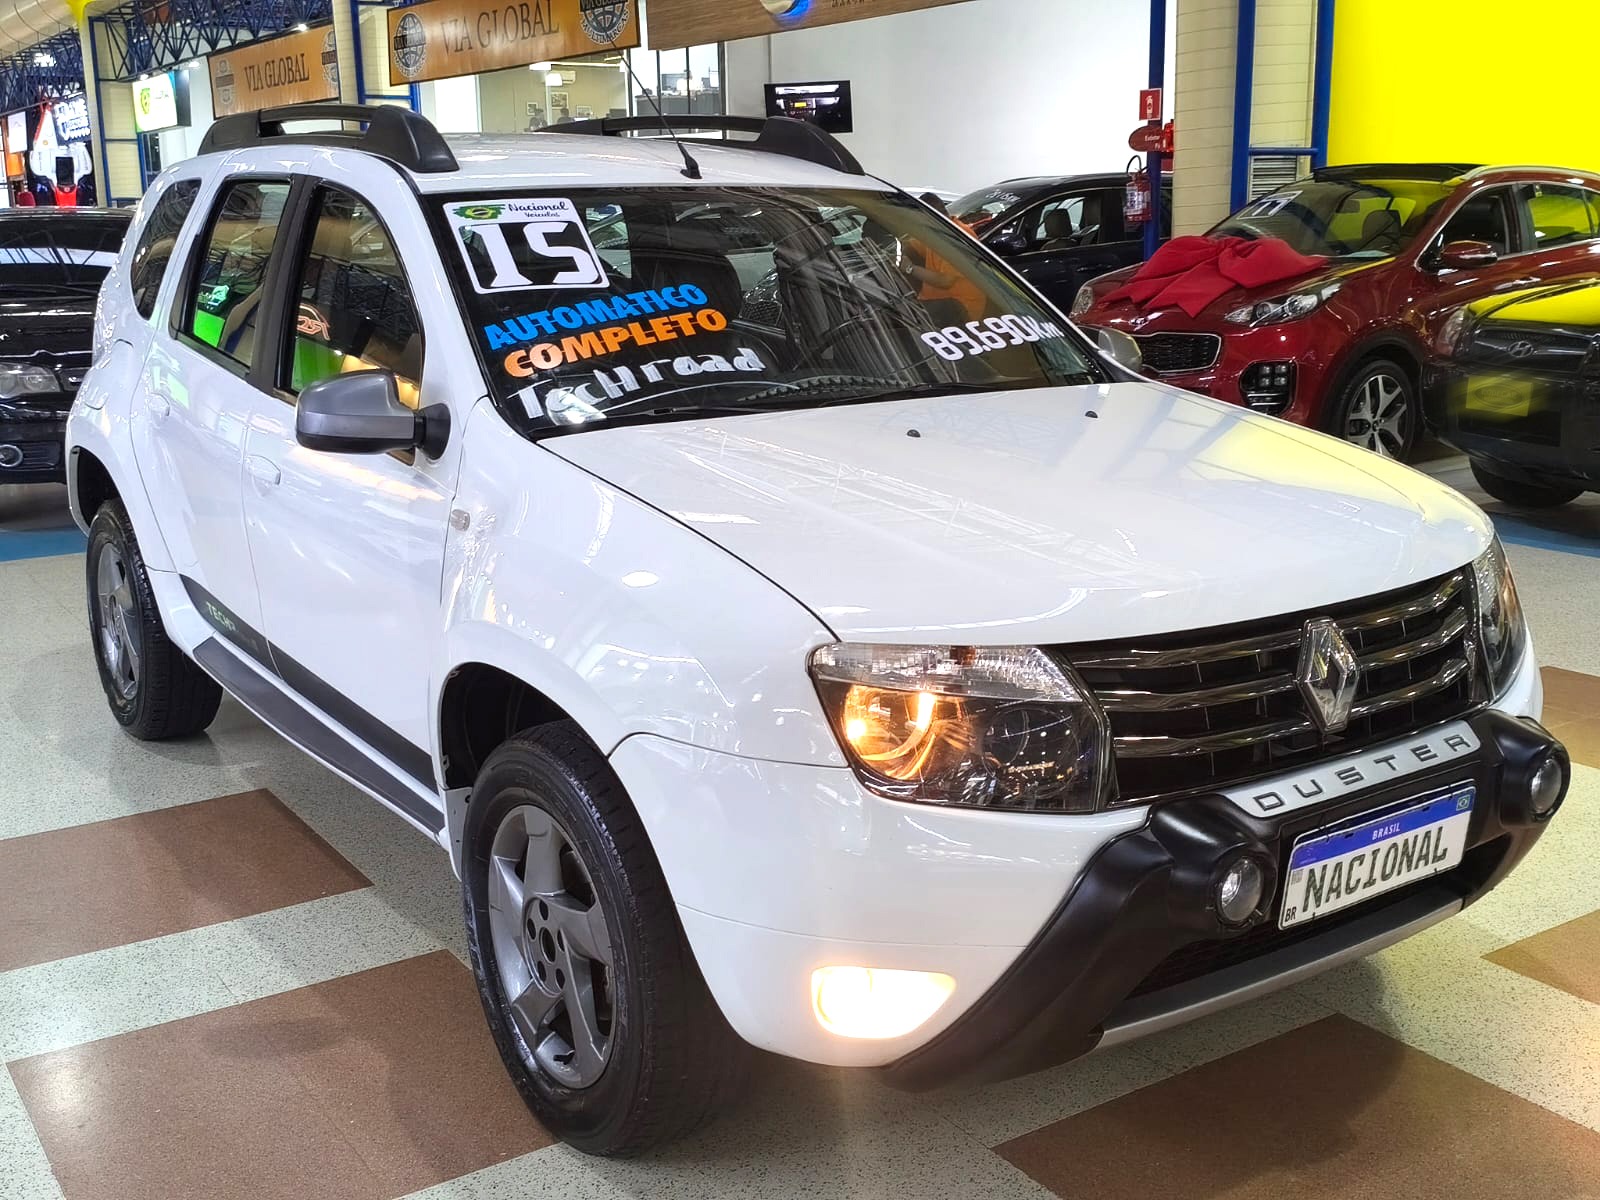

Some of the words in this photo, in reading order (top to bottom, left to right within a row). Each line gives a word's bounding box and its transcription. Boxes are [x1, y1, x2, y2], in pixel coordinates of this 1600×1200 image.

[441, 16, 473, 55] VIA
[476, 0, 560, 49] GLOBAL
[244, 65, 264, 92] VIA
[264, 53, 310, 89] GLOBAL
[508, 201, 569, 212] Nacional
[470, 221, 600, 287] 15
[484, 283, 708, 349] AUTOMATICO
[504, 309, 727, 377] COMPLETO
[1252, 735, 1471, 812] DUSTER
[1372, 822, 1401, 841] BRASIL
[1302, 826, 1448, 913] NACIONAL
[1284, 906, 1297, 922] BR
